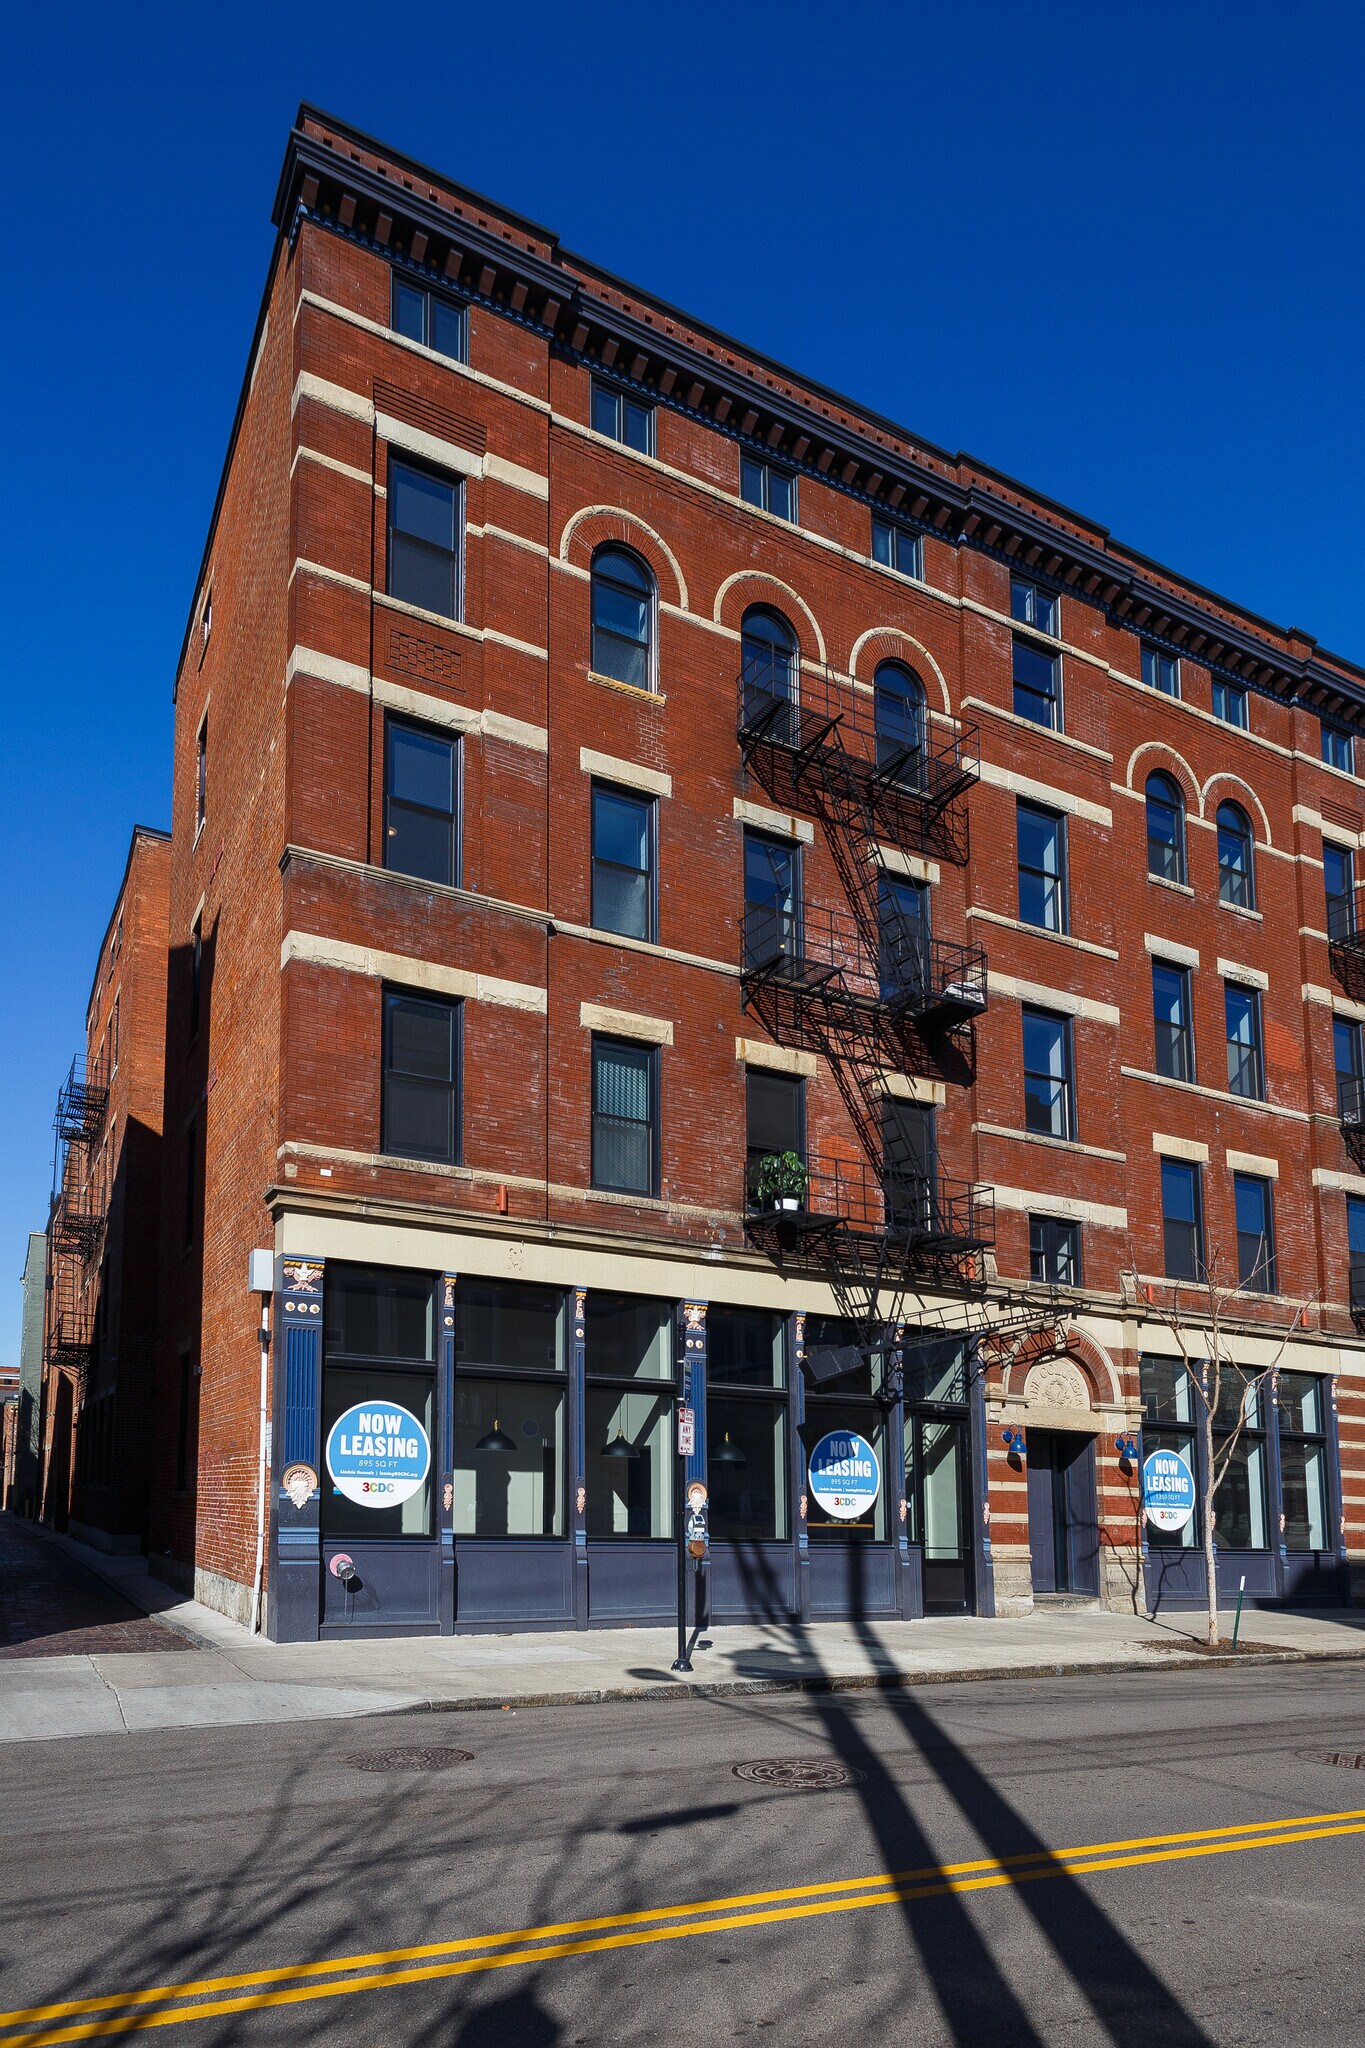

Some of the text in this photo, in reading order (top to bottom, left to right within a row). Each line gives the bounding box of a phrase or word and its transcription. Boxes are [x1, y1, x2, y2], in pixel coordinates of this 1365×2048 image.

[359, 1413, 402, 1435] NOW
[340, 1434, 419, 1458] LEASING
[830, 1440, 860, 1458] NOW
[358, 1459, 373, 1468] 895
[375, 1460, 387, 1468] SQ
[818, 1458, 872, 1478] LEASING
[1155, 1459, 1179, 1475] NOW
[362, 1482, 395, 1493] 3CDC
[1146, 1475, 1189, 1493] LEASING
[834, 1497, 857, 1506] 3CDC
[1160, 1511, 1178, 1519] 3CDC
